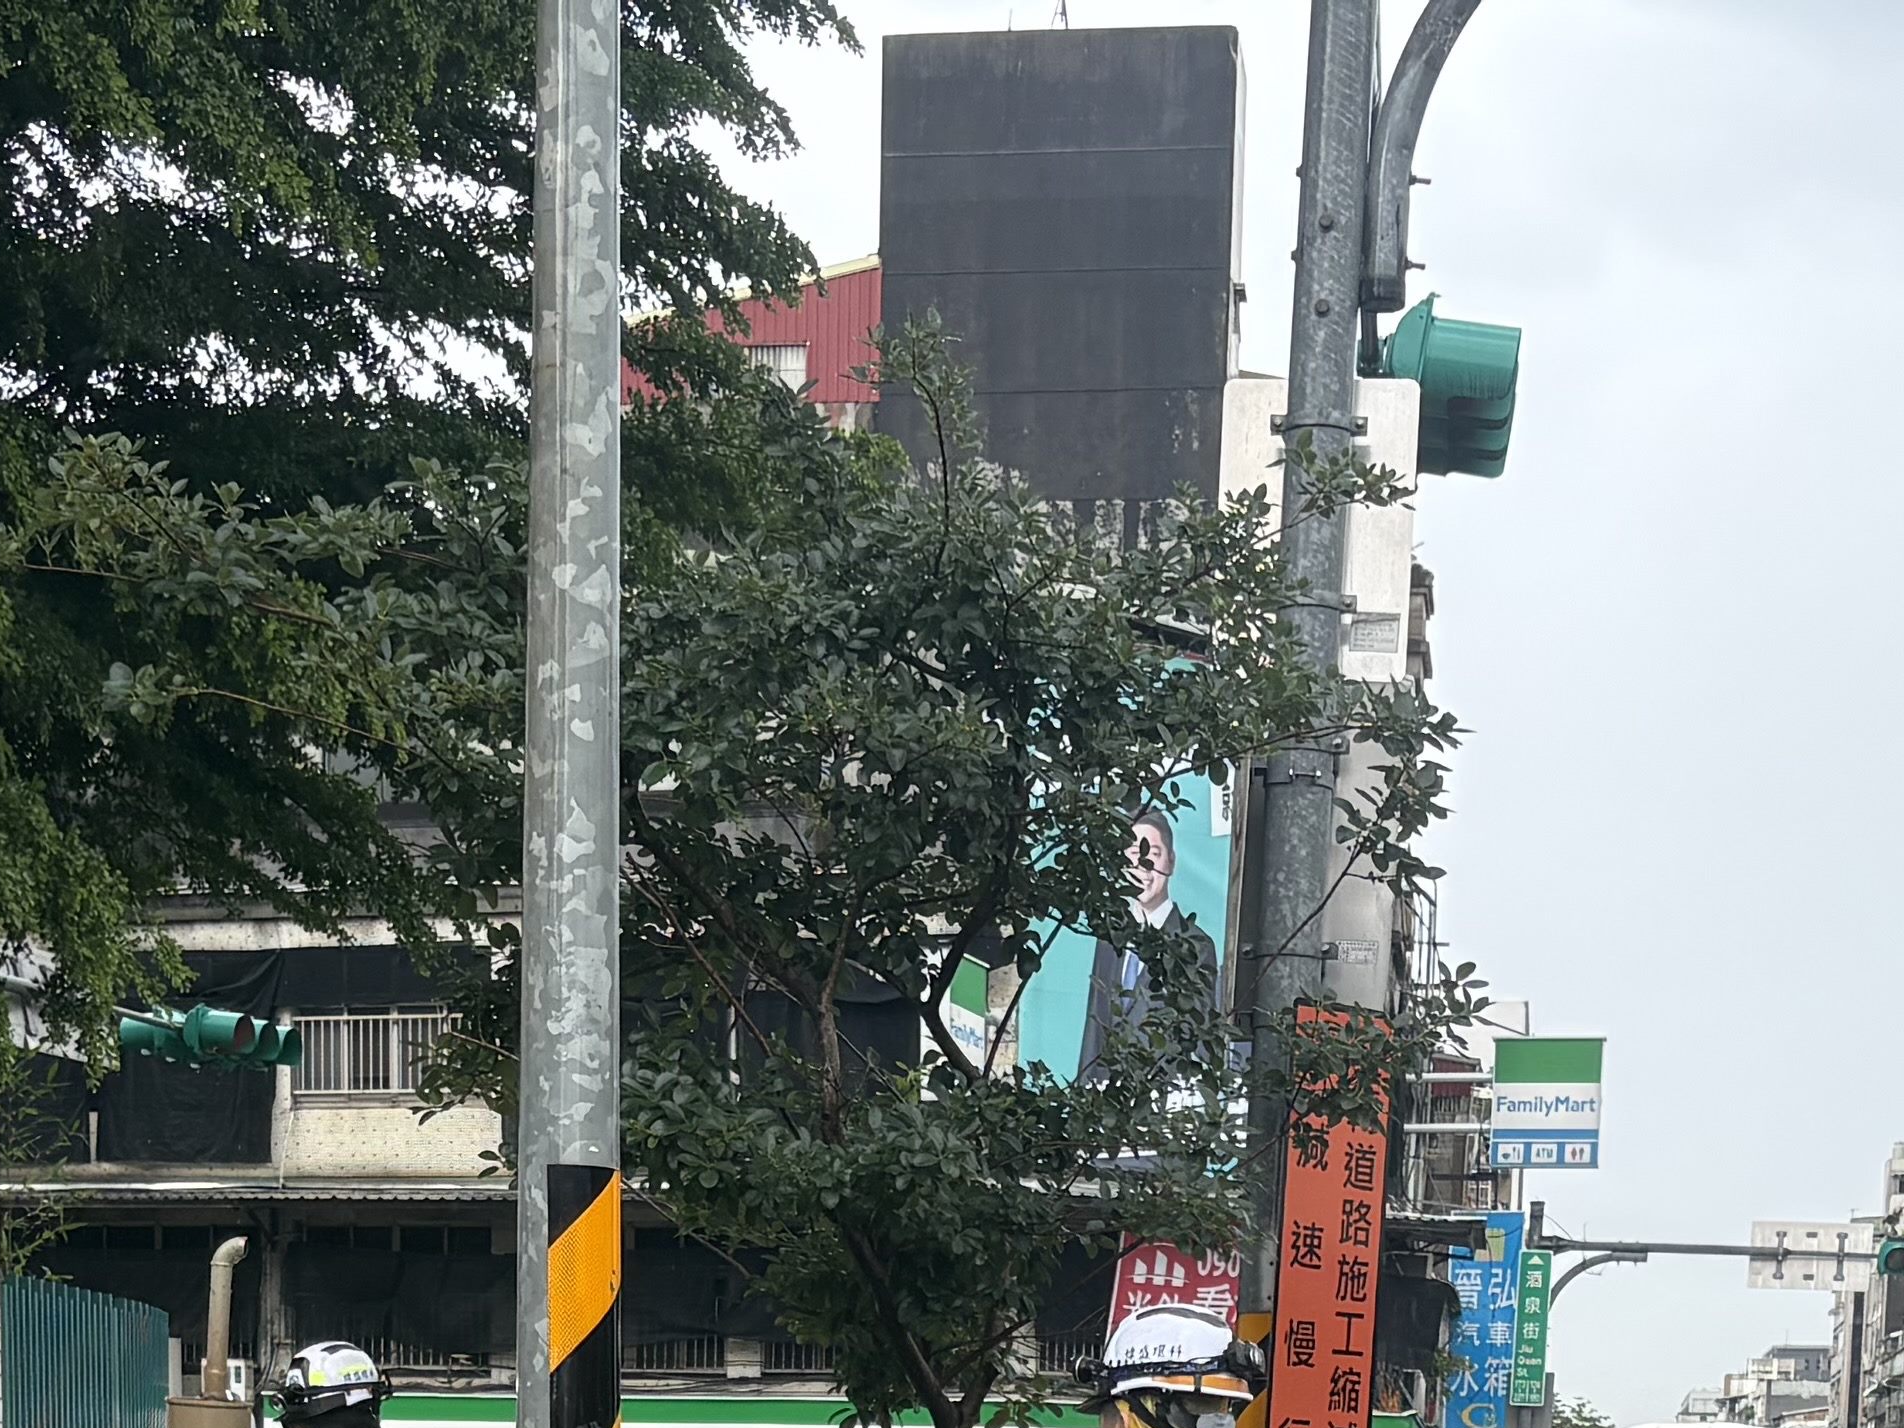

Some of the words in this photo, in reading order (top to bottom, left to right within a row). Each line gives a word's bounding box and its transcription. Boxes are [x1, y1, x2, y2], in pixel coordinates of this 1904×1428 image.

[1497, 1096, 1596, 1117] FamilyMart
[1536, 1148, 1553, 1158] ATM
[1454, 1268, 1516, 1311] 晉弘
[1523, 1271, 1543, 1339] 酒泉街
[1456, 1321, 1512, 1347] 汽車
[1450, 1356, 1512, 1397] 水箱
